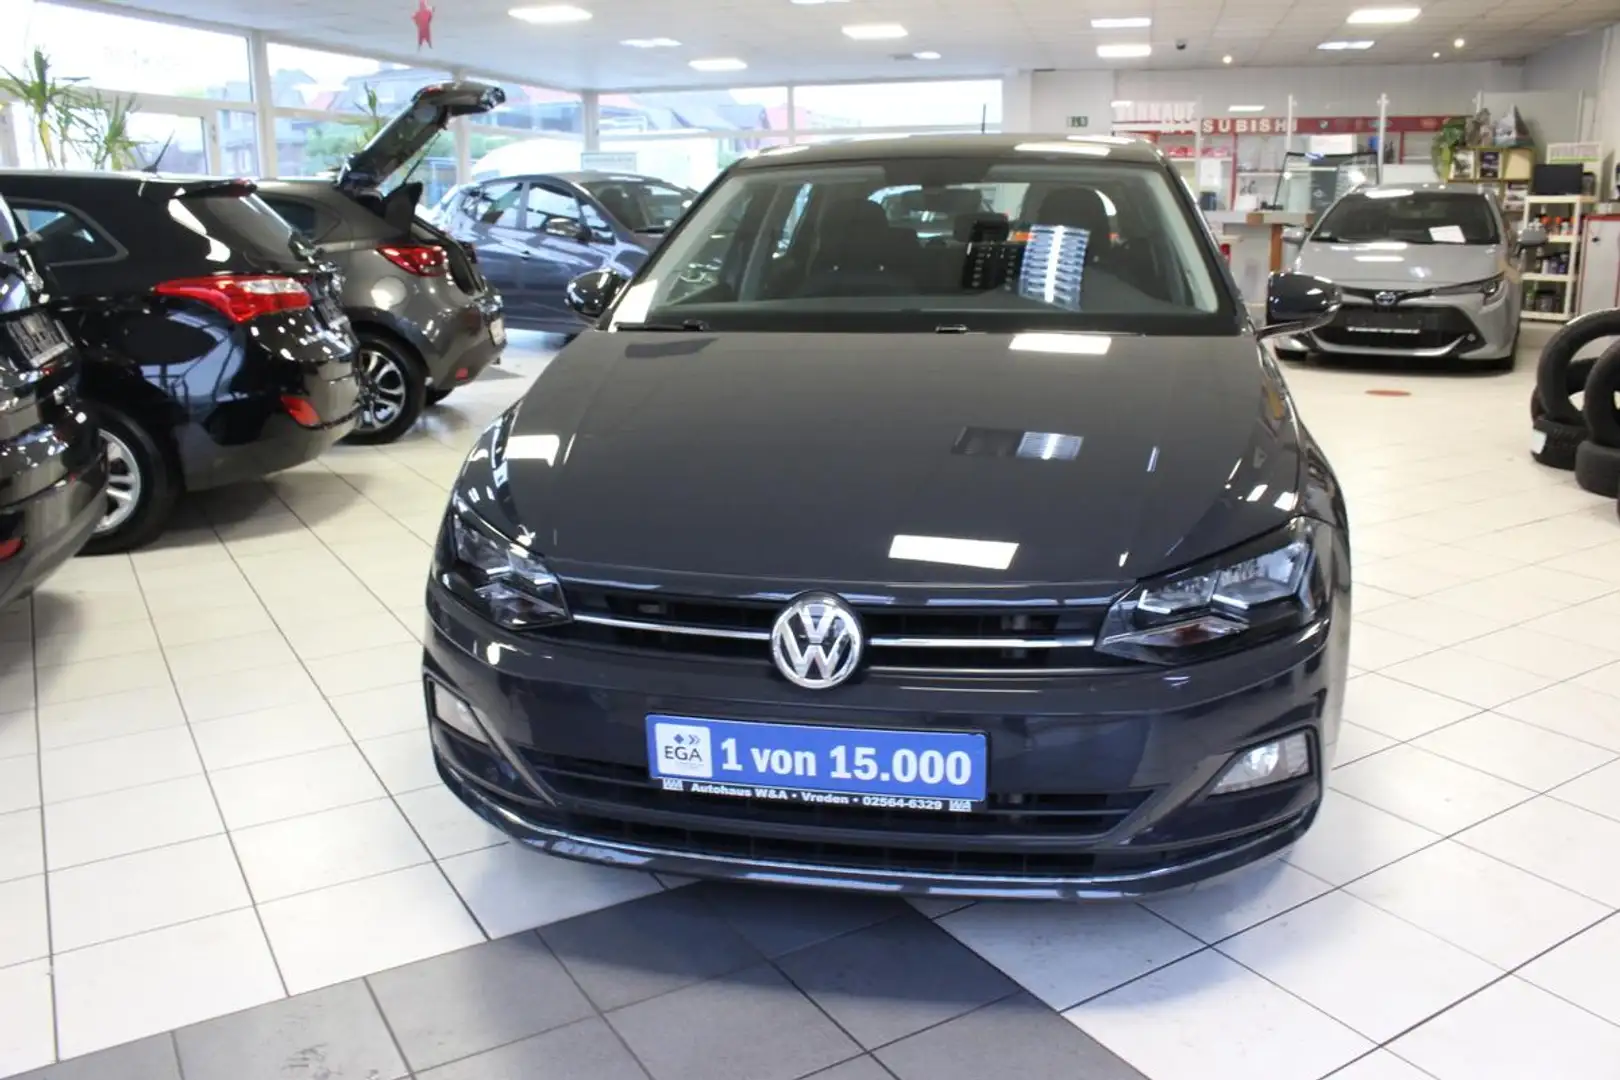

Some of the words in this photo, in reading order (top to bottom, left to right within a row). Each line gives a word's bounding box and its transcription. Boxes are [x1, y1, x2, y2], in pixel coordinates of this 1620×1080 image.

[664, 745, 702, 762] EGA
[721, 738, 743, 771] 1
[751, 748, 817, 777] von
[829, 745, 972, 785] 15.000
[690, 783, 753, 798] Autohaus
[755, 788, 788, 800] W&A
[801, 791, 849, 805] Vreden
[863, 796, 943, 811] 02564-6329
